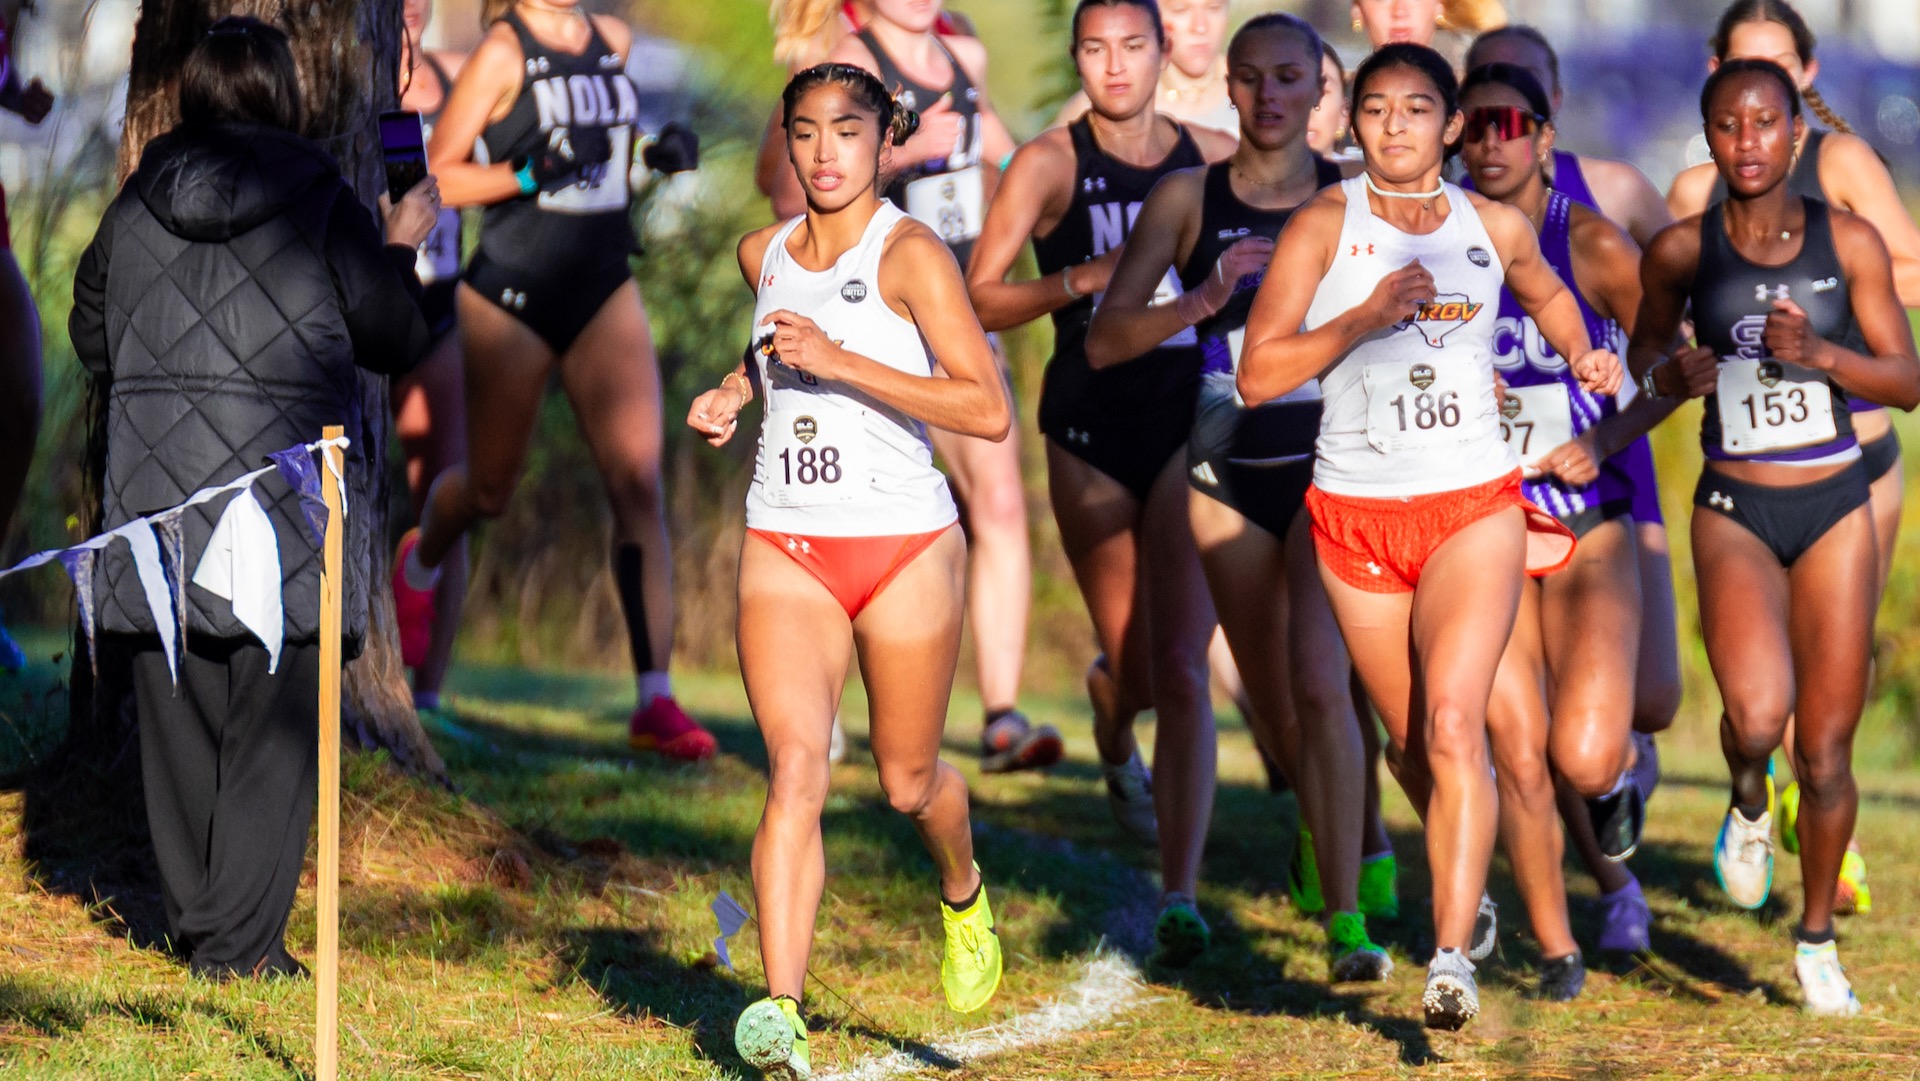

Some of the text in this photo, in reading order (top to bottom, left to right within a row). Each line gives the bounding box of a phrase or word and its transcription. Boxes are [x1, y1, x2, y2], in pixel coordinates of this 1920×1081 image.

[533, 74, 638, 132] NOLA
[1218, 228, 1249, 239] SLC
[1390, 390, 1461, 431] 186
[1742, 387, 1809, 429] 153
[779, 446, 842, 485] 188
